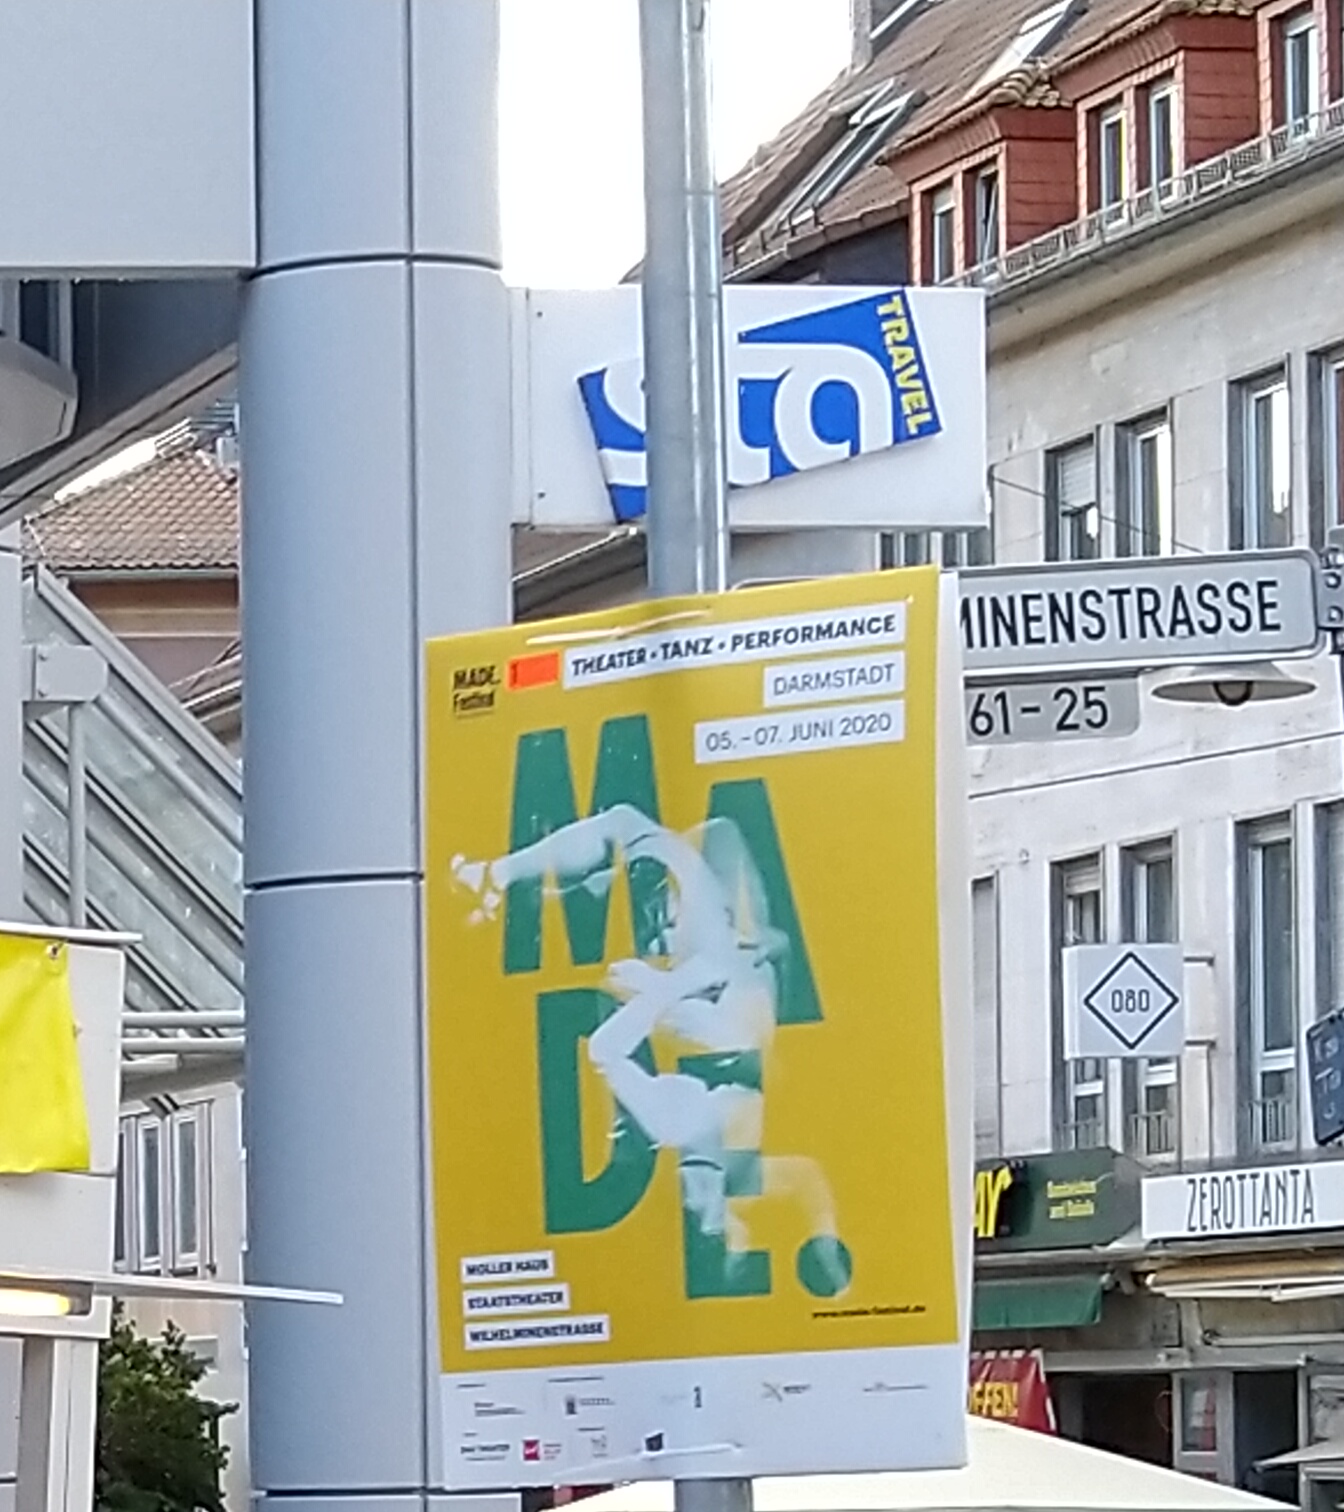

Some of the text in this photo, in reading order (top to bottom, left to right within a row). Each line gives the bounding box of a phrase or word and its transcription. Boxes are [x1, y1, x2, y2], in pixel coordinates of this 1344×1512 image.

[876, 294, 934, 435] TRAVEL
[571, 614, 897, 677] THEATER TANZ PERFORMANCE
[772, 662, 896, 696] DARMSTADT
[789, 718, 834, 743] JUNI
[839, 712, 892, 737] 2020
[1186, 1168, 1315, 1233] ZEROTTANTA
